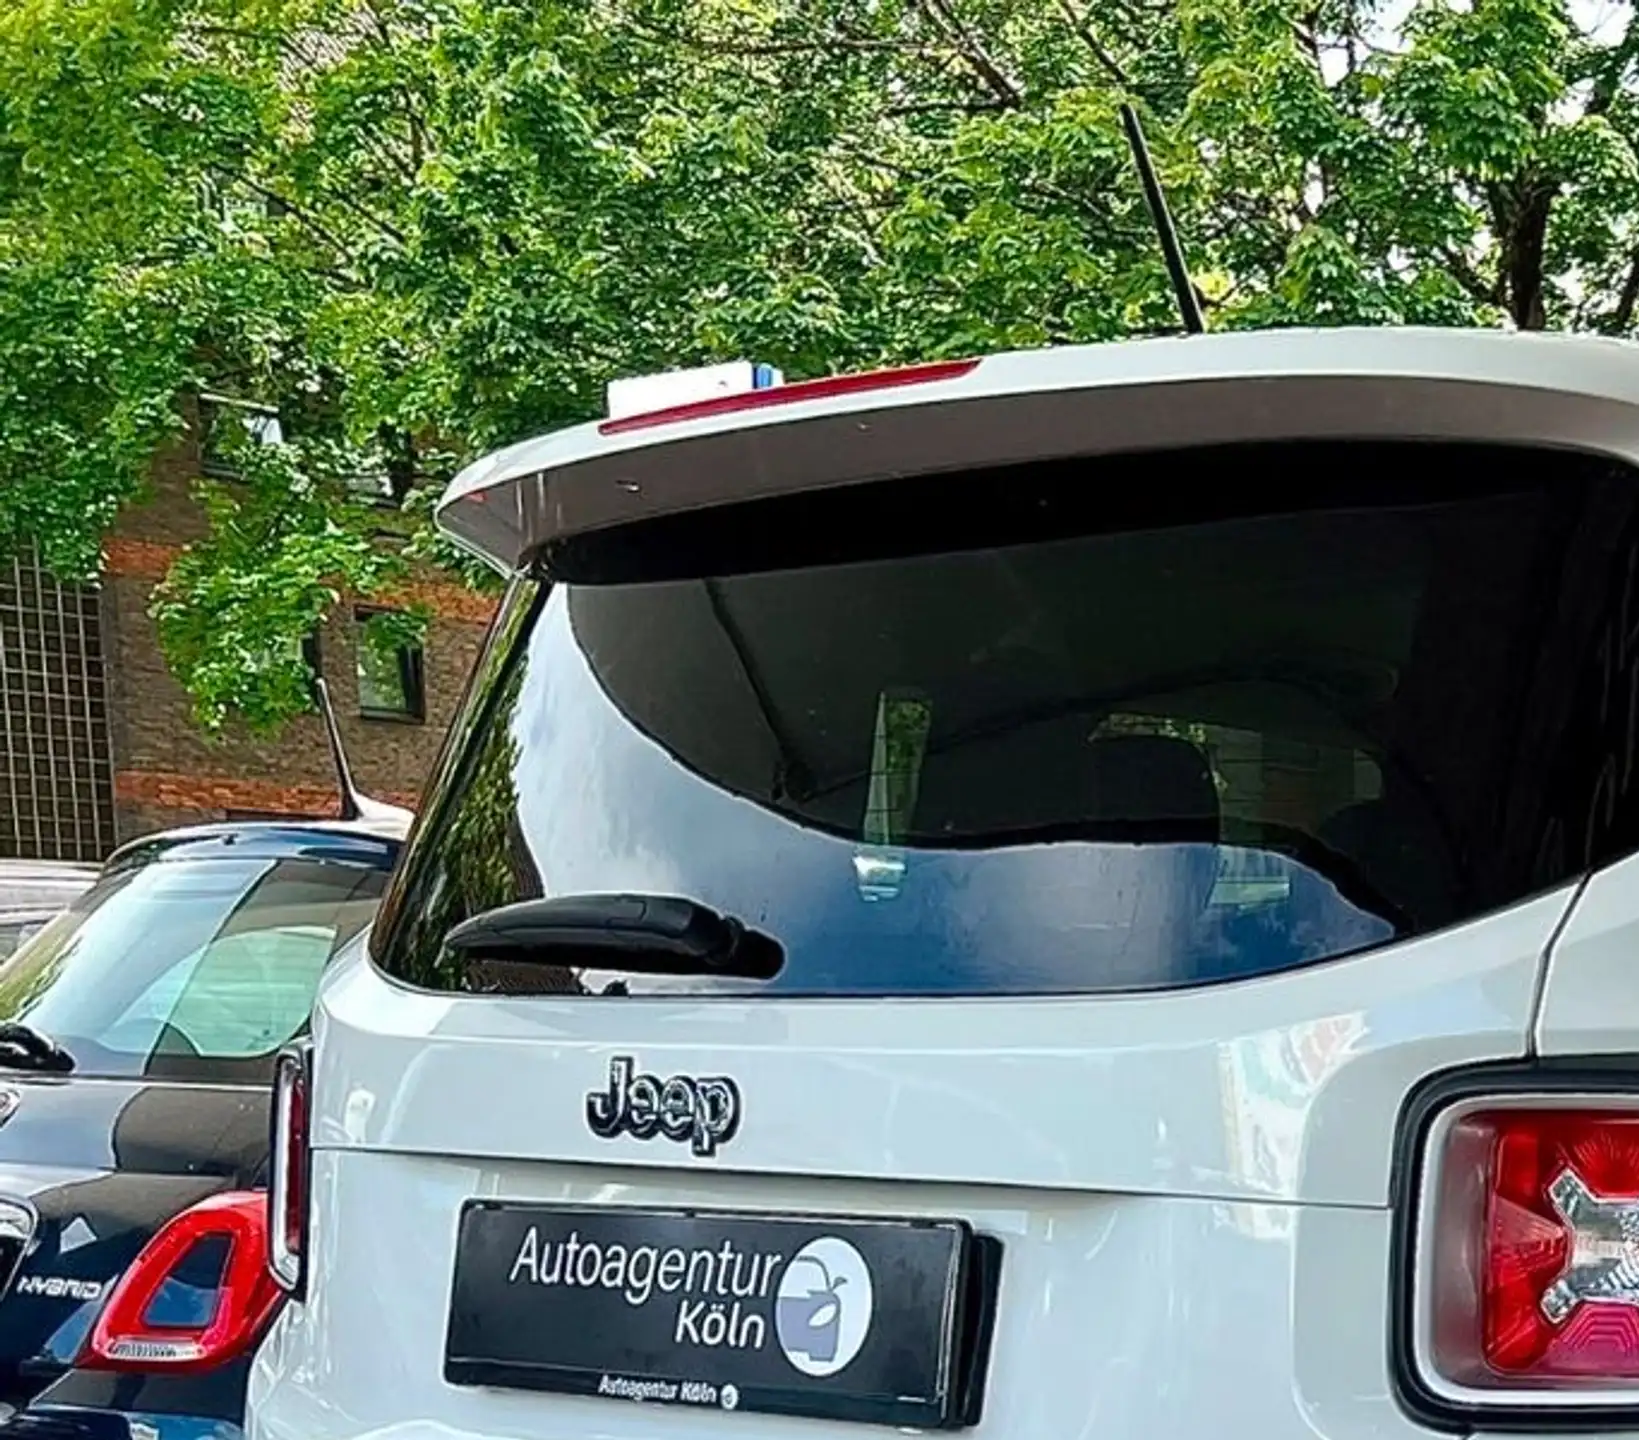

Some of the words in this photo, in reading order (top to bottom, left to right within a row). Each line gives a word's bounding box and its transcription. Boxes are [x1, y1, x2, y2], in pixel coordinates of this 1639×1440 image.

[586, 1055, 741, 1157] Jeep
[16, 1276, 102, 1300] HYBRID
[510, 1226, 782, 1304] Autoagentur
[675, 1300, 766, 1349] Köln
[598, 1374, 678, 1401] Autoagentur
[680, 1381, 717, 1403] Köln
